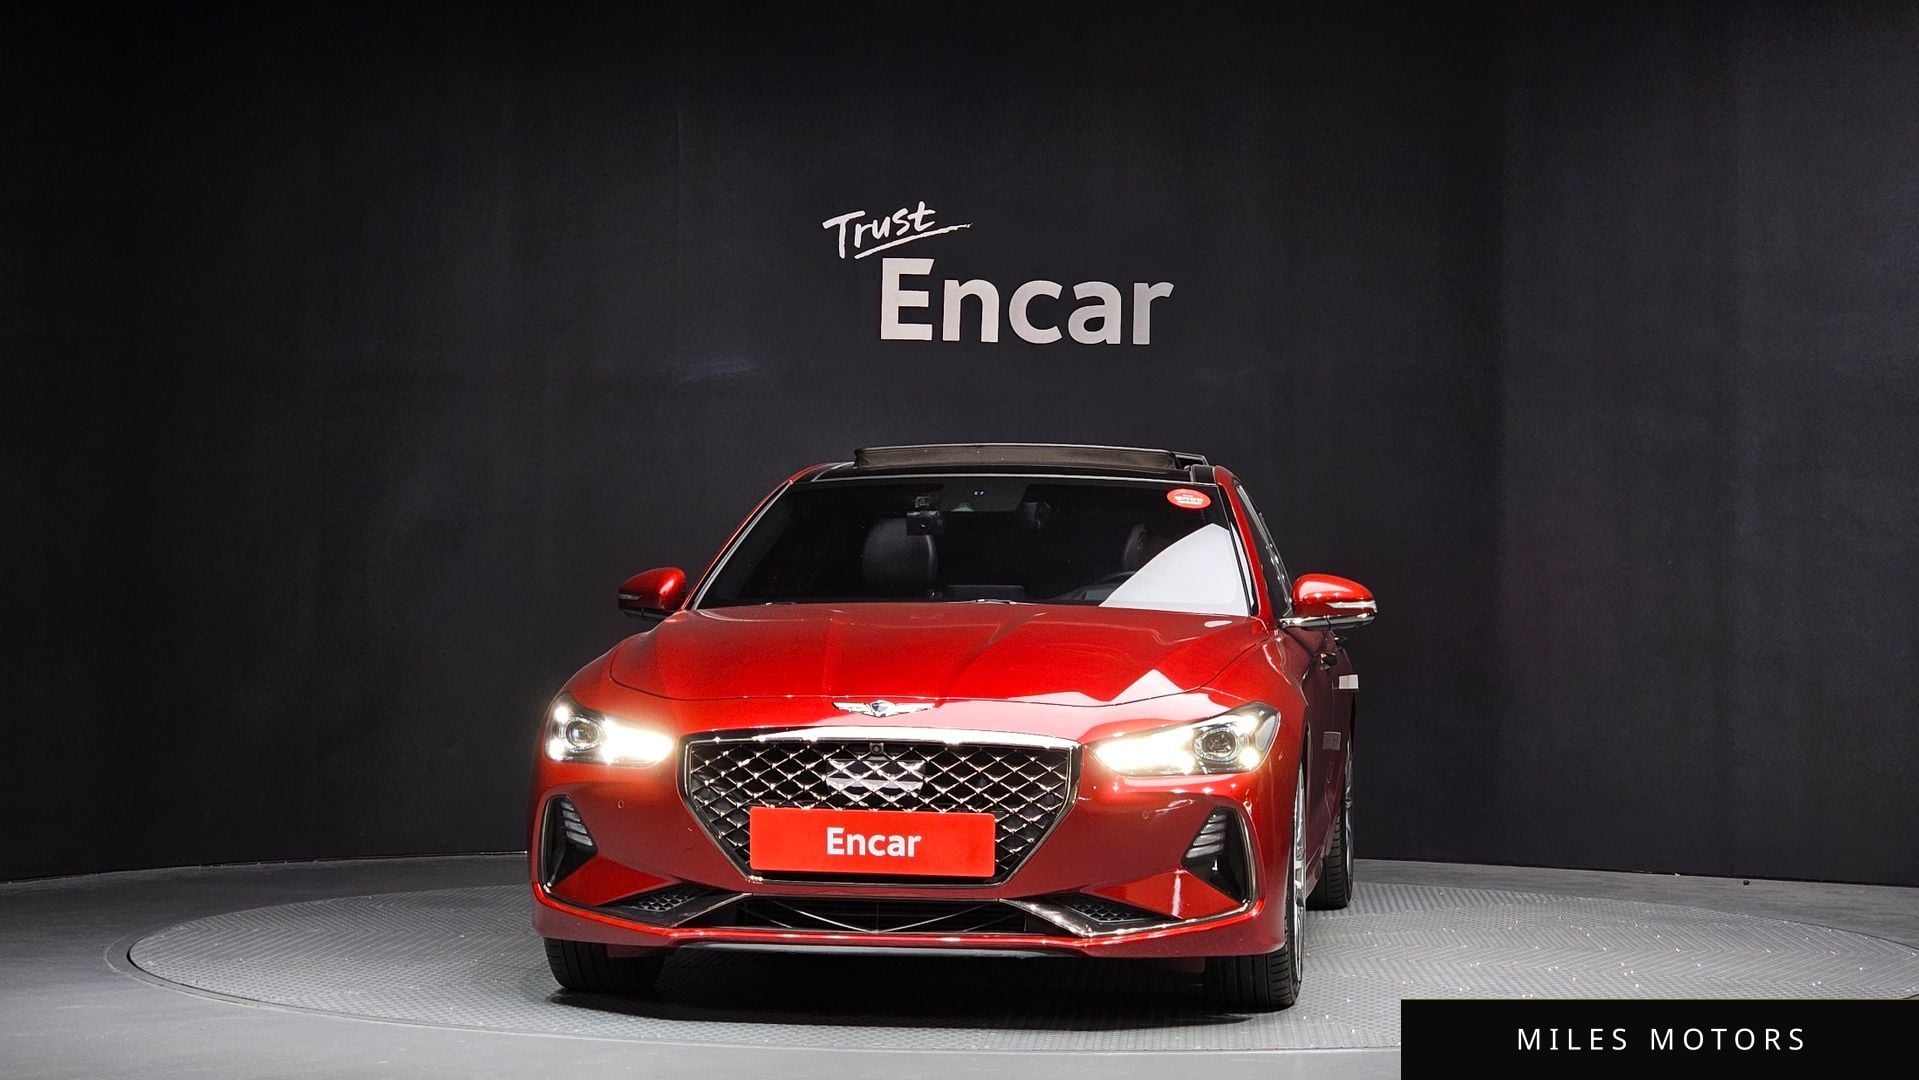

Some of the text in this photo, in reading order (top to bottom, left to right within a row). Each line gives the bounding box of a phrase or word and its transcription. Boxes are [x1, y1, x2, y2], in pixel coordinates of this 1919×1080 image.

[822, 200, 938, 259] Trust
[880, 257, 1175, 345] Encar
[826, 827, 922, 858] Encar
